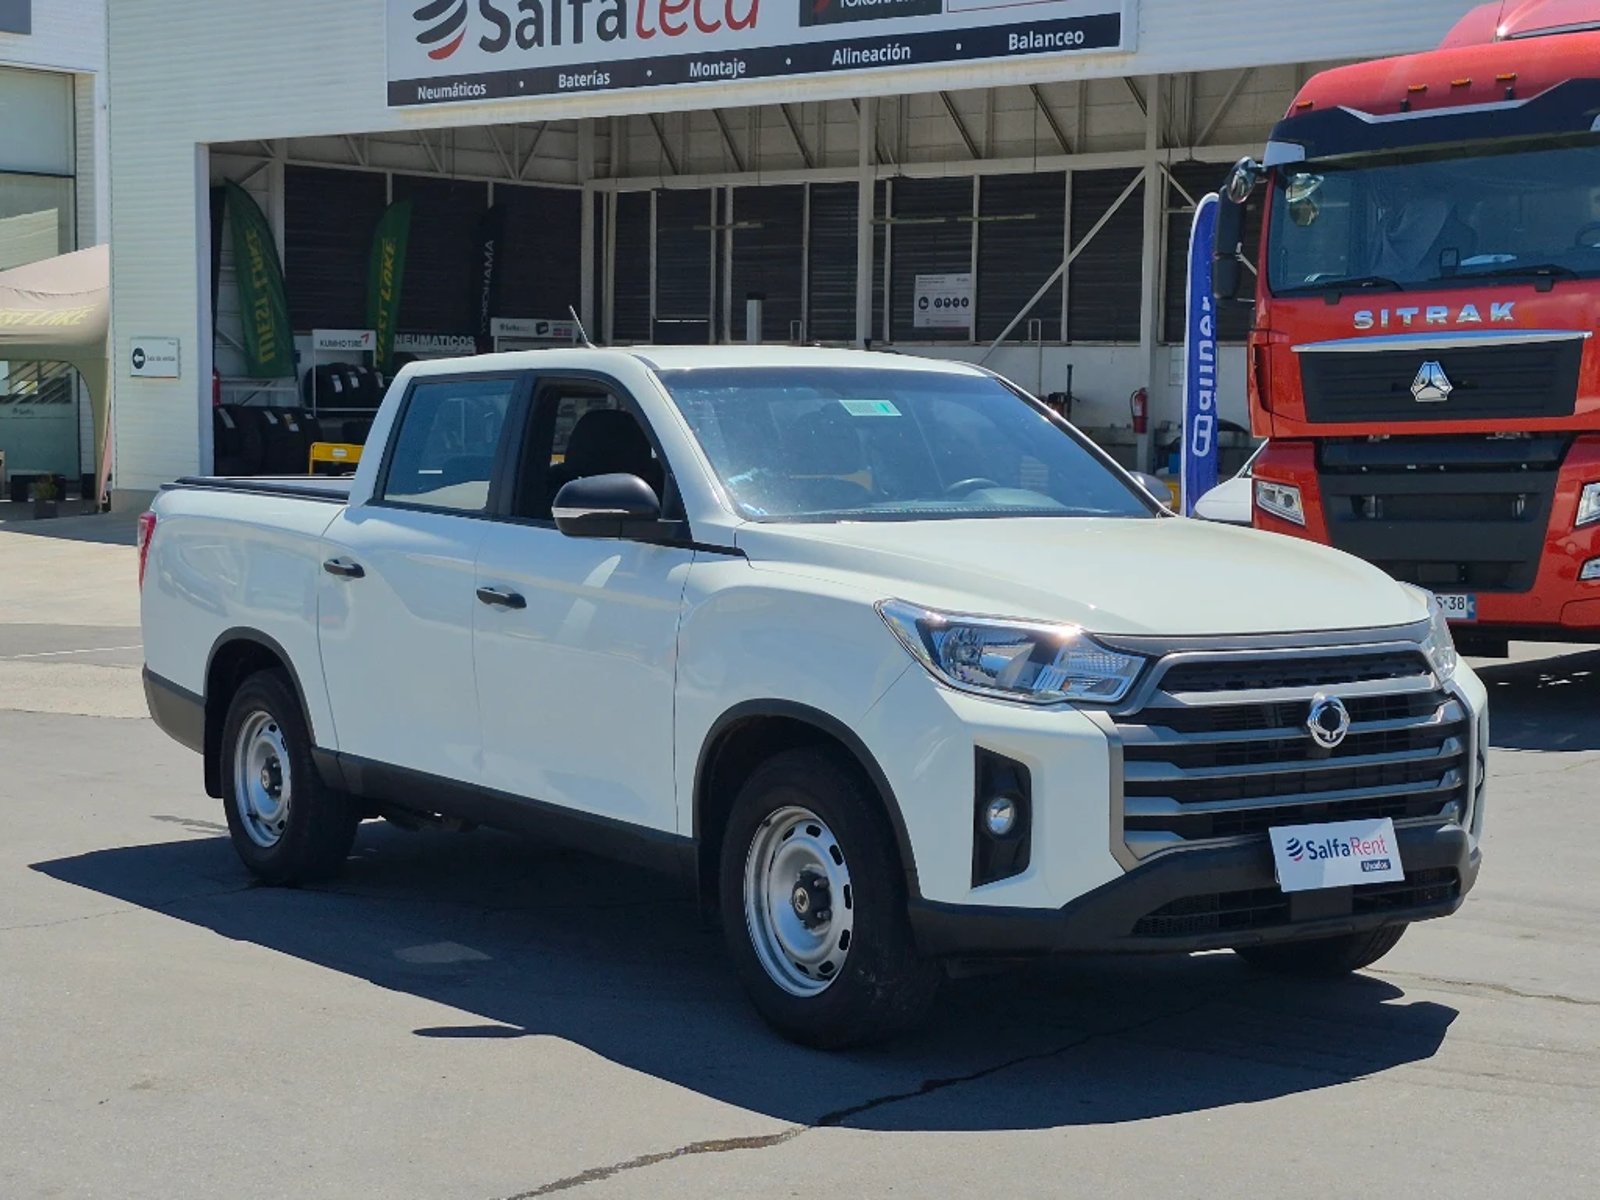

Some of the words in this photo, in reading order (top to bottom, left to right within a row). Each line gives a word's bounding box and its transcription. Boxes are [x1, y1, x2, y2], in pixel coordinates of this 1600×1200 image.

[417, 82, 487, 101] Neumáticos
[558, 70, 611, 89] Baterías
[689, 57, 746, 79] Montaje
[831, 44, 912, 66] Alineación
[1008, 28, 1084, 51] Balanceo
[1353, 301, 1516, 330] SITRAK
[394, 333, 475, 348] NEUMATICOS
[1305, 834, 1388, 860] SalfaRent
